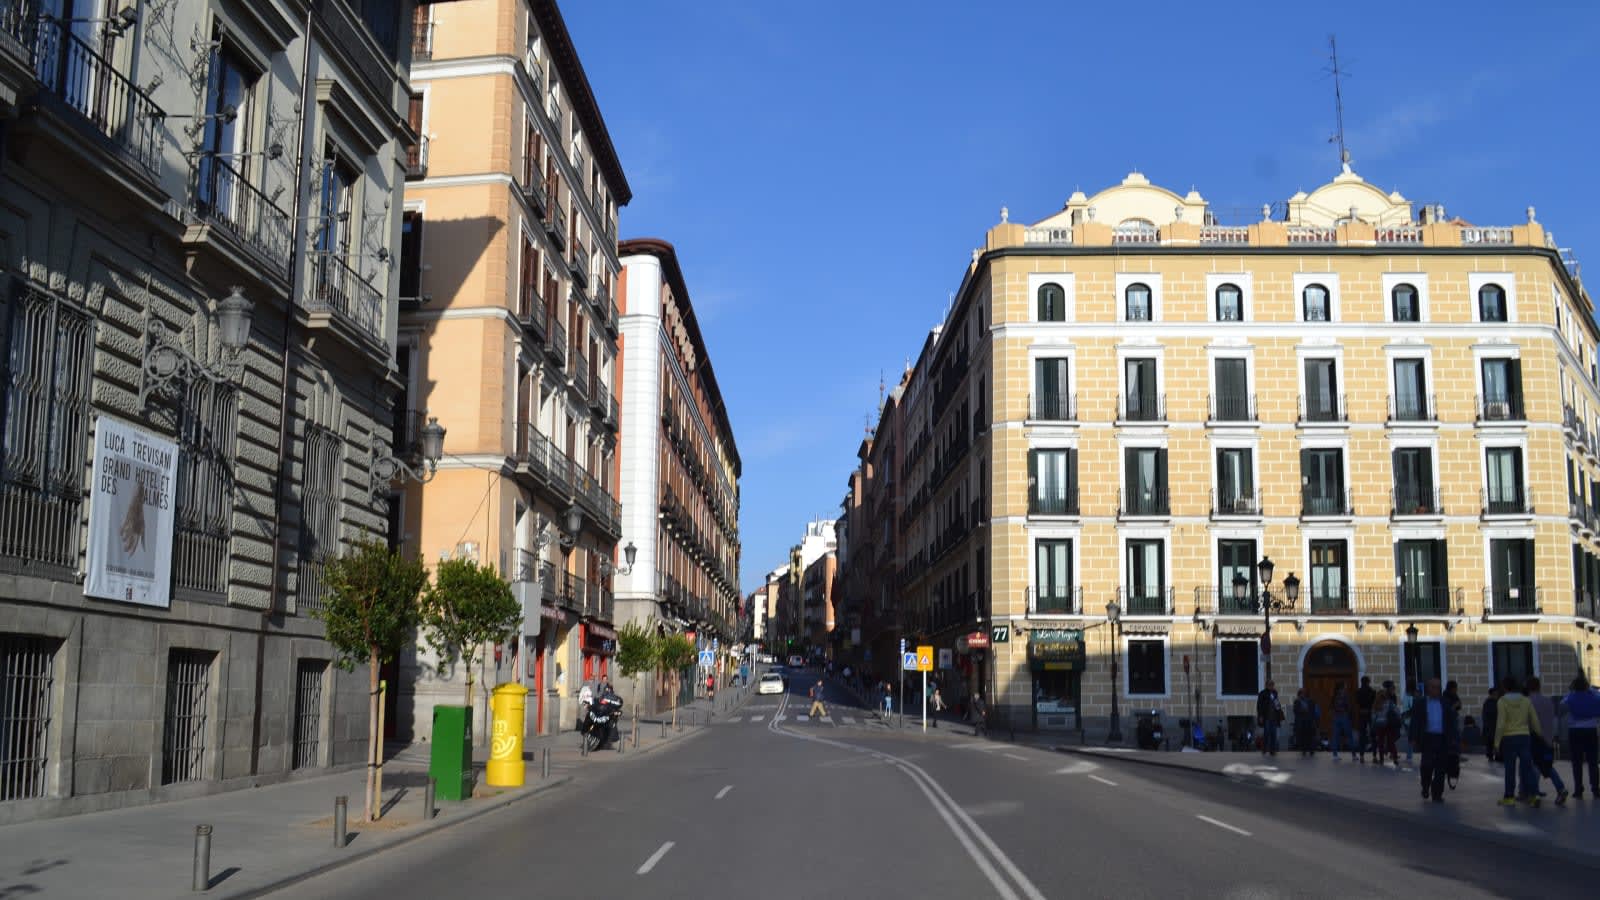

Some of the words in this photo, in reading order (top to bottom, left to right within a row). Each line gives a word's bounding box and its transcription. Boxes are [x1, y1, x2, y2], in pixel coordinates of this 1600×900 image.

[105, 432, 125, 454] LUCA
[133, 441, 172, 470] TREVISANI
[101, 475, 117, 495] DES
[142, 487, 169, 510] ALMES
[103, 456, 131, 480] GRAND
[135, 467, 157, 489] HOTEL
[160, 475, 170, 494] ET
[993, 627, 1008, 641] 77
